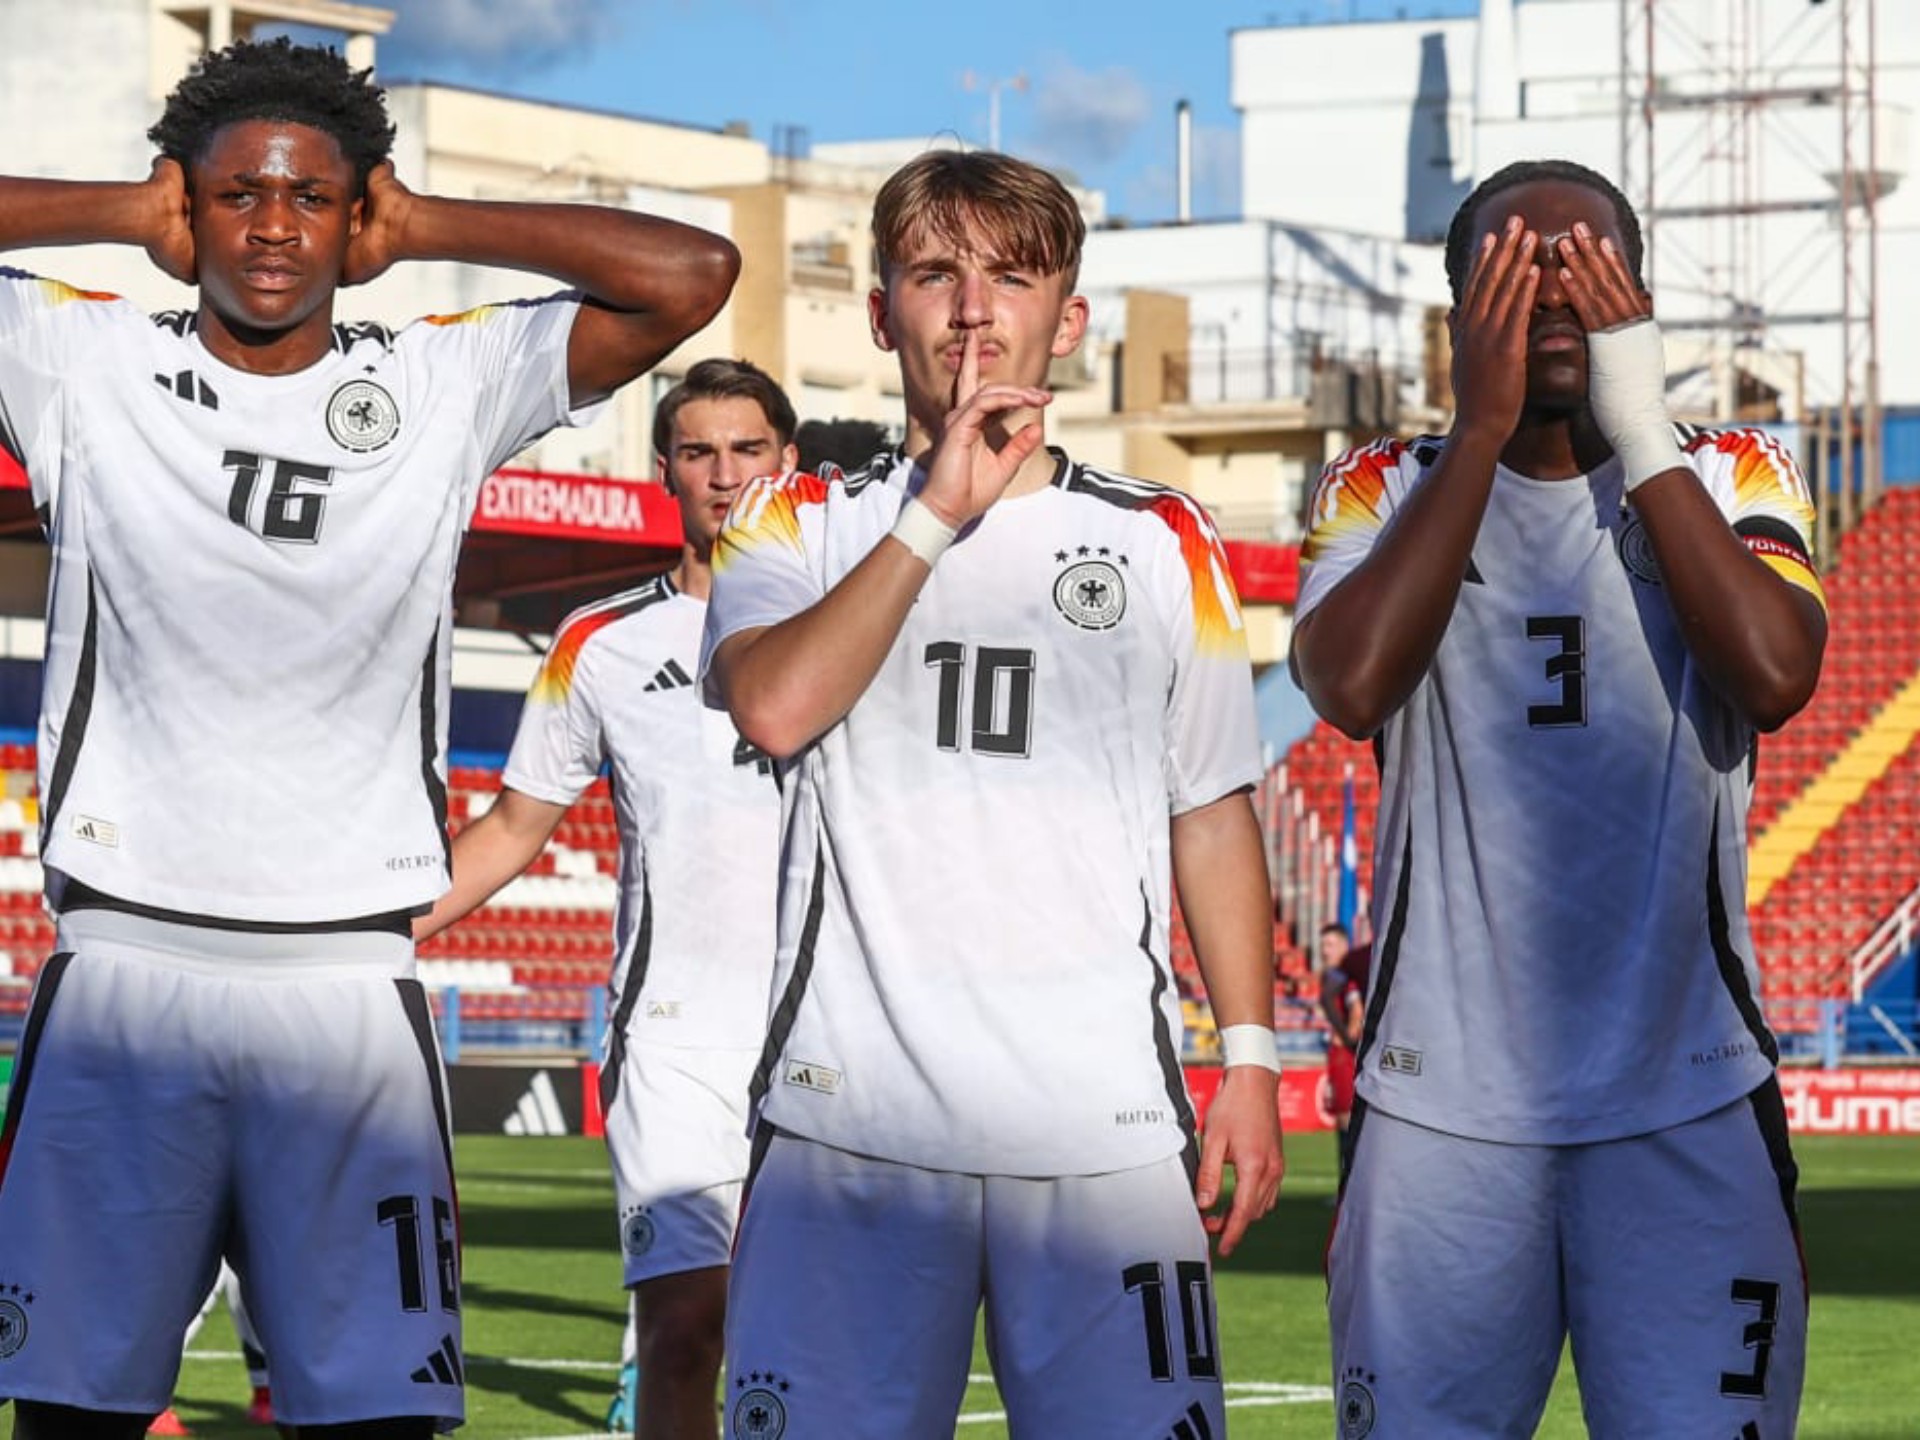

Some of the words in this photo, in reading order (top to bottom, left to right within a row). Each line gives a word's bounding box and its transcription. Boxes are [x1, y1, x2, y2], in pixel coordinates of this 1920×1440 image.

[221, 449, 334, 545] 16
[480, 476, 645, 532] EXTREMADURA
[923, 640, 1036, 760] 10
[1526, 615, 1588, 729] 3
[1122, 1260, 1219, 1383] 10
[1720, 1278, 1781, 1401] 3
